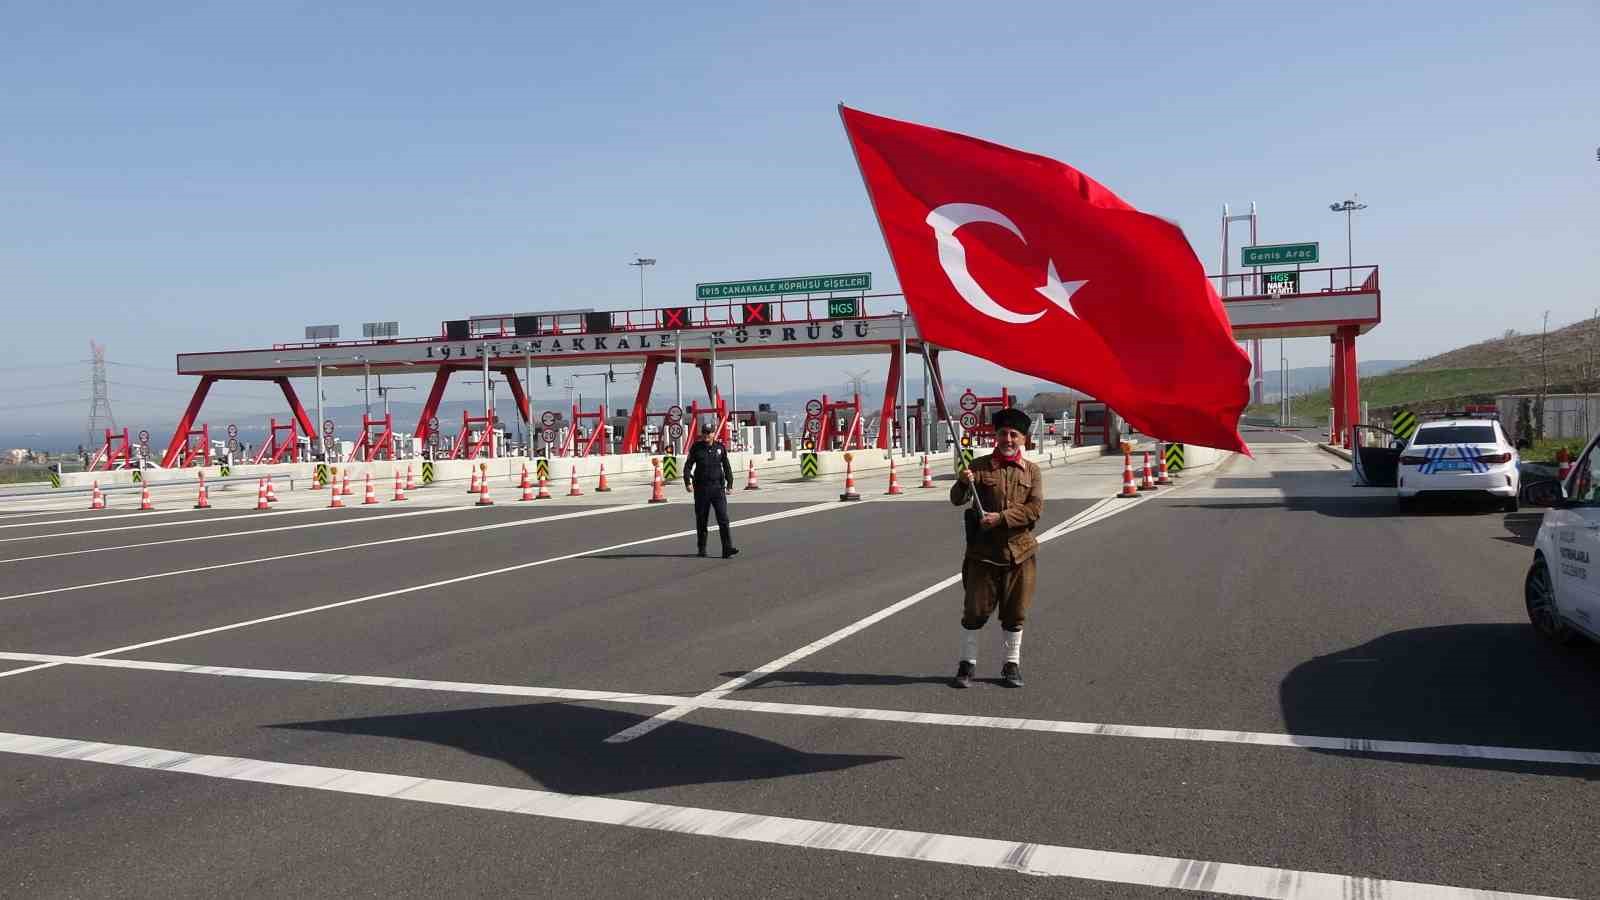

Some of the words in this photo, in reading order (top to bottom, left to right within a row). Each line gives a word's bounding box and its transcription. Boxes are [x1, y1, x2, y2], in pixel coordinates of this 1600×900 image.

[1271, 273, 1288, 281] HGS
[701, 286, 720, 296] 1915
[830, 302, 854, 315] HGS
[711, 321, 869, 345] KÖPRÜSÜ
[963, 415, 975, 426] 20
[671, 427, 681, 435] 20
